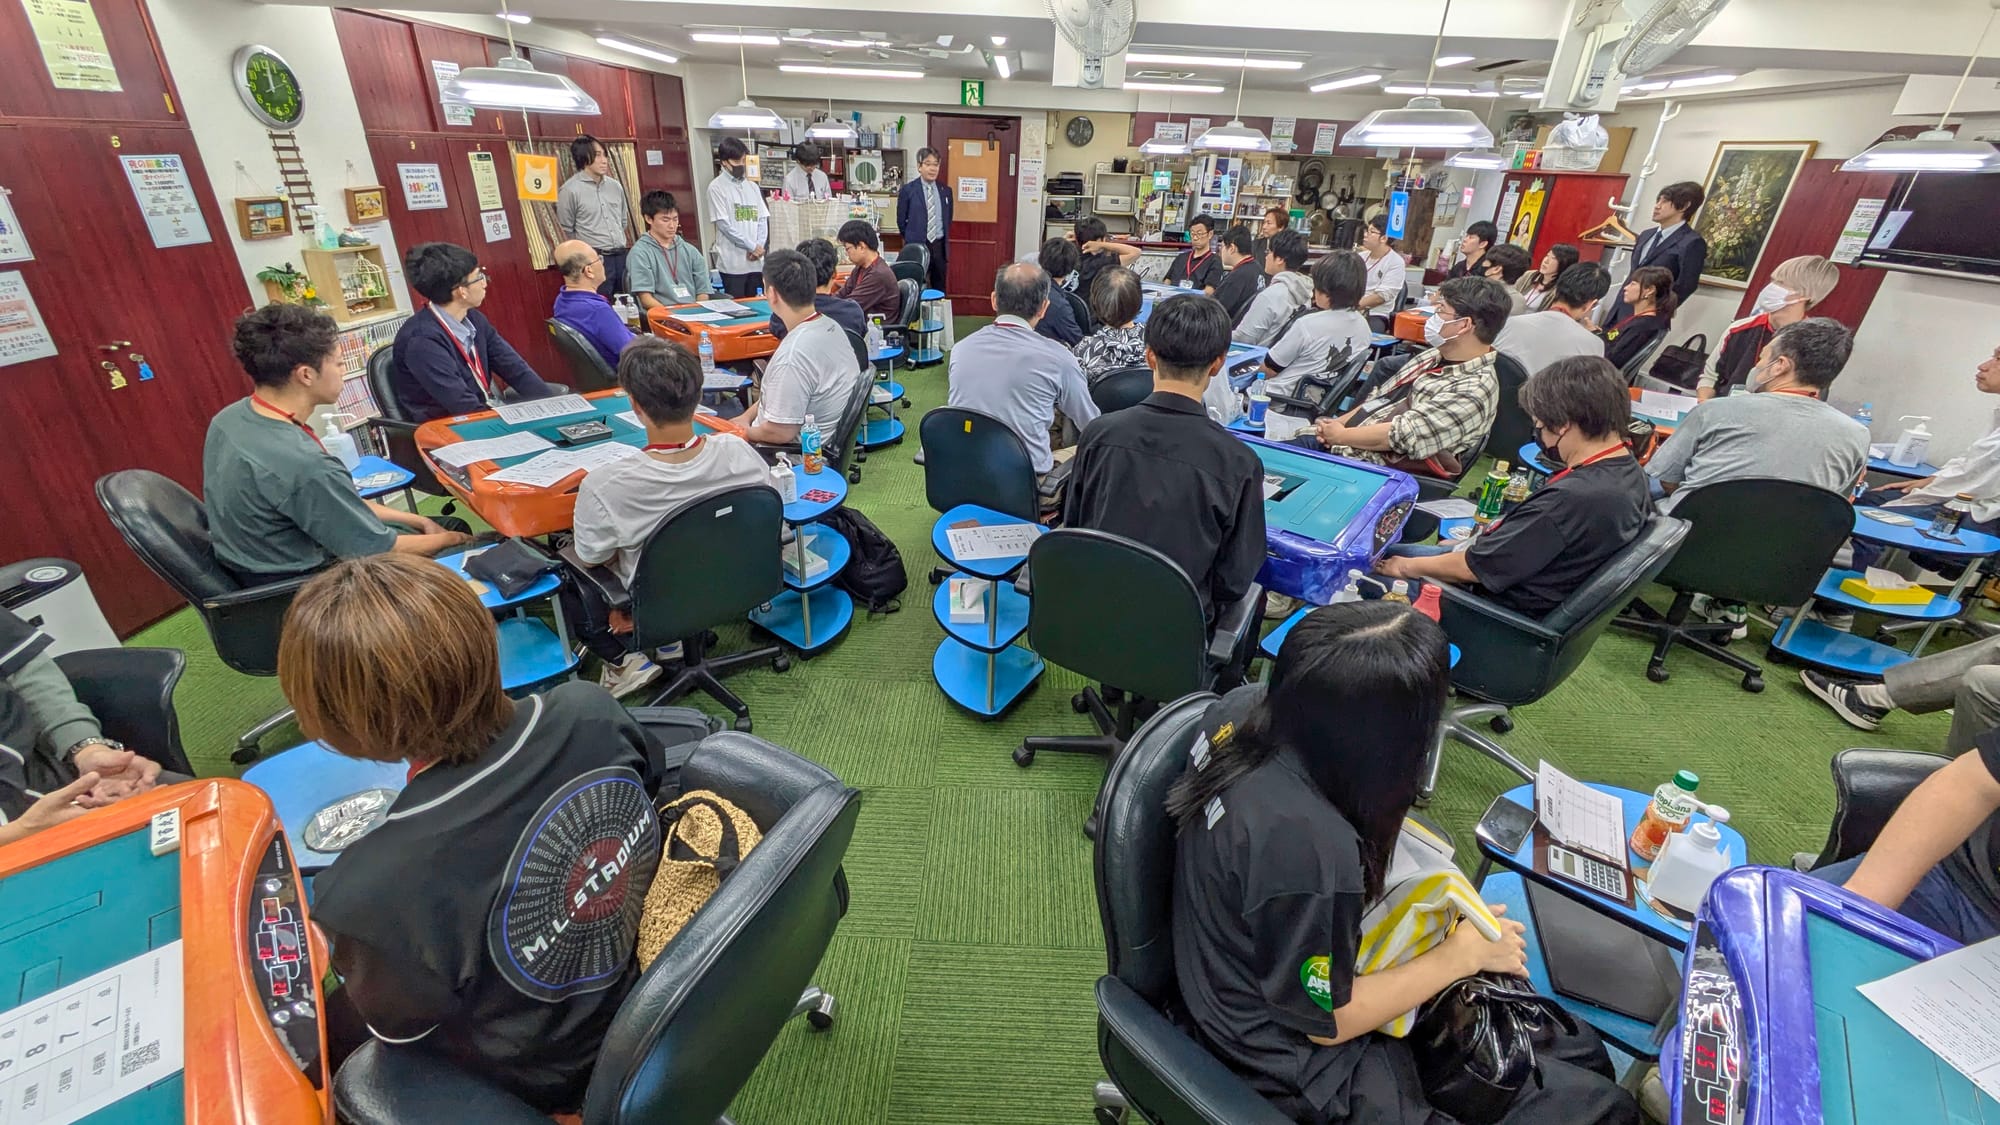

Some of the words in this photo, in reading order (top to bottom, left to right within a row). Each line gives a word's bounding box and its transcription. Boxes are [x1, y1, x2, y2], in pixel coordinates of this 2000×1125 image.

[534, 178, 542, 189] 9
[1882, 229, 1891, 239] 2
[1656, 790, 1691, 813] Tropiana
[58, 1031, 80, 1045] 7
[25, 1043, 47, 1058] 8
